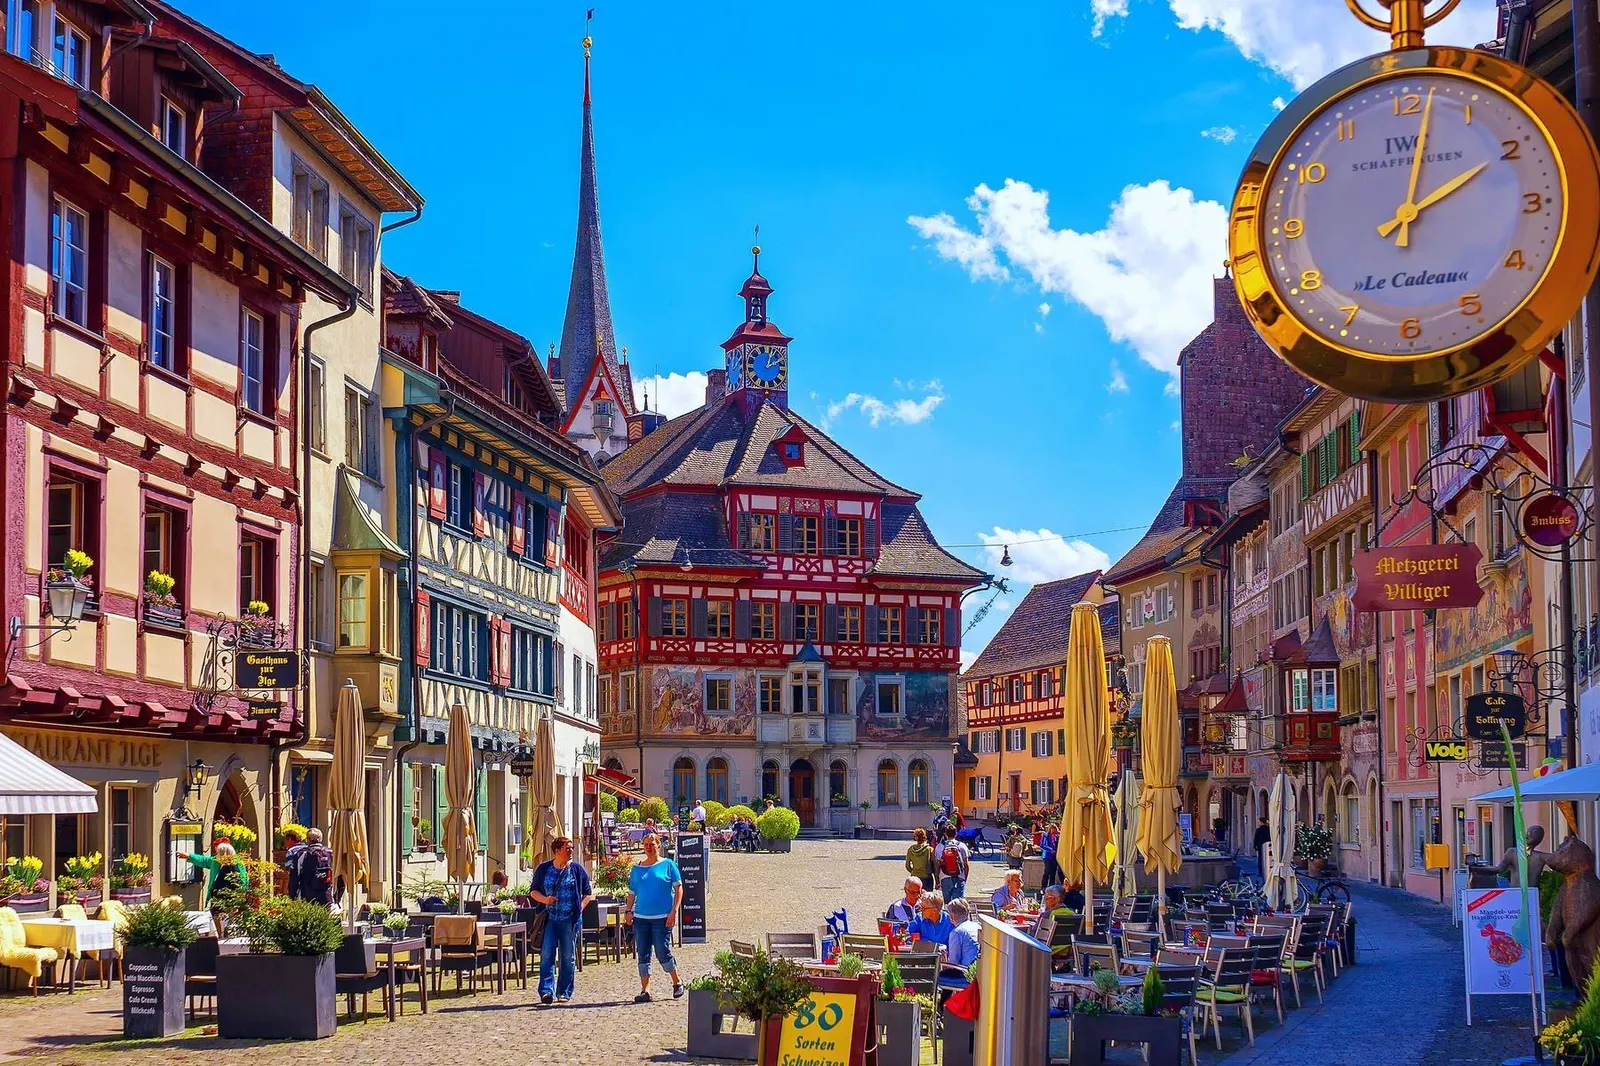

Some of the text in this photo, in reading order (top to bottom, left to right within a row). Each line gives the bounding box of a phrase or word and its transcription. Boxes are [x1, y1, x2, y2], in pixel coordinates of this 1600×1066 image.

[1393, 94, 1421, 116] 12
[1337, 119, 1354, 141] 11
[1500, 140, 1520, 160] 2
[1299, 162, 1326, 184] 10
[1523, 192, 1541, 214] 3
[1283, 219, 1303, 239] 9
[1504, 250, 1525, 270] 4
[1300, 270, 1321, 290] 8
[1459, 293, 1481, 315] 5
[1339, 305, 1359, 326] 7
[1400, 317, 1421, 339] 6
[1530, 515, 1571, 526] Imbiss
[1375, 553, 1459, 576] Metzgerei
[1384, 582, 1451, 602] Villiger
[246, 654, 288, 666] Gasthaus
[260, 666, 274, 675] zur
[250, 706, 278, 715] Zimmer
[1426, 742, 1467, 760] Volg
[131, 985, 155, 993] Espresso
[794, 1001, 843, 1031] 80
[794, 1035, 836, 1051] Sorten
